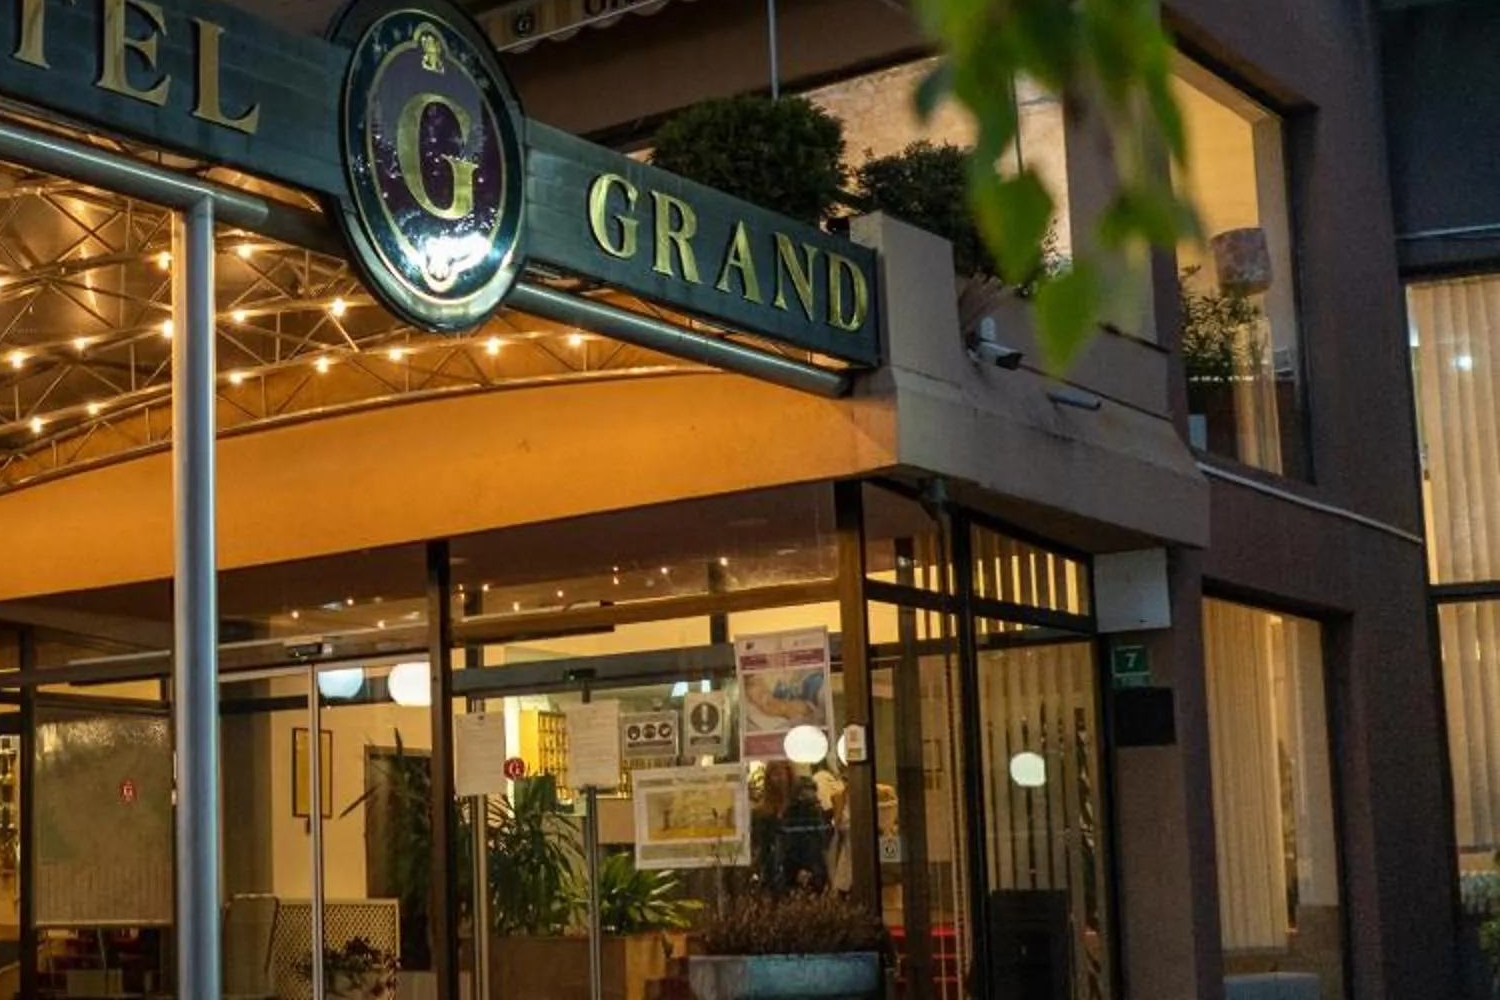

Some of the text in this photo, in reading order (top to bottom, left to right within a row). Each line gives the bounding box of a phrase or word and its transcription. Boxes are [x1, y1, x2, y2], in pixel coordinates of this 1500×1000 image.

[397, 93, 479, 221] G
[590, 172, 870, 333] GRAND
[1125, 653, 1137, 668] 7
